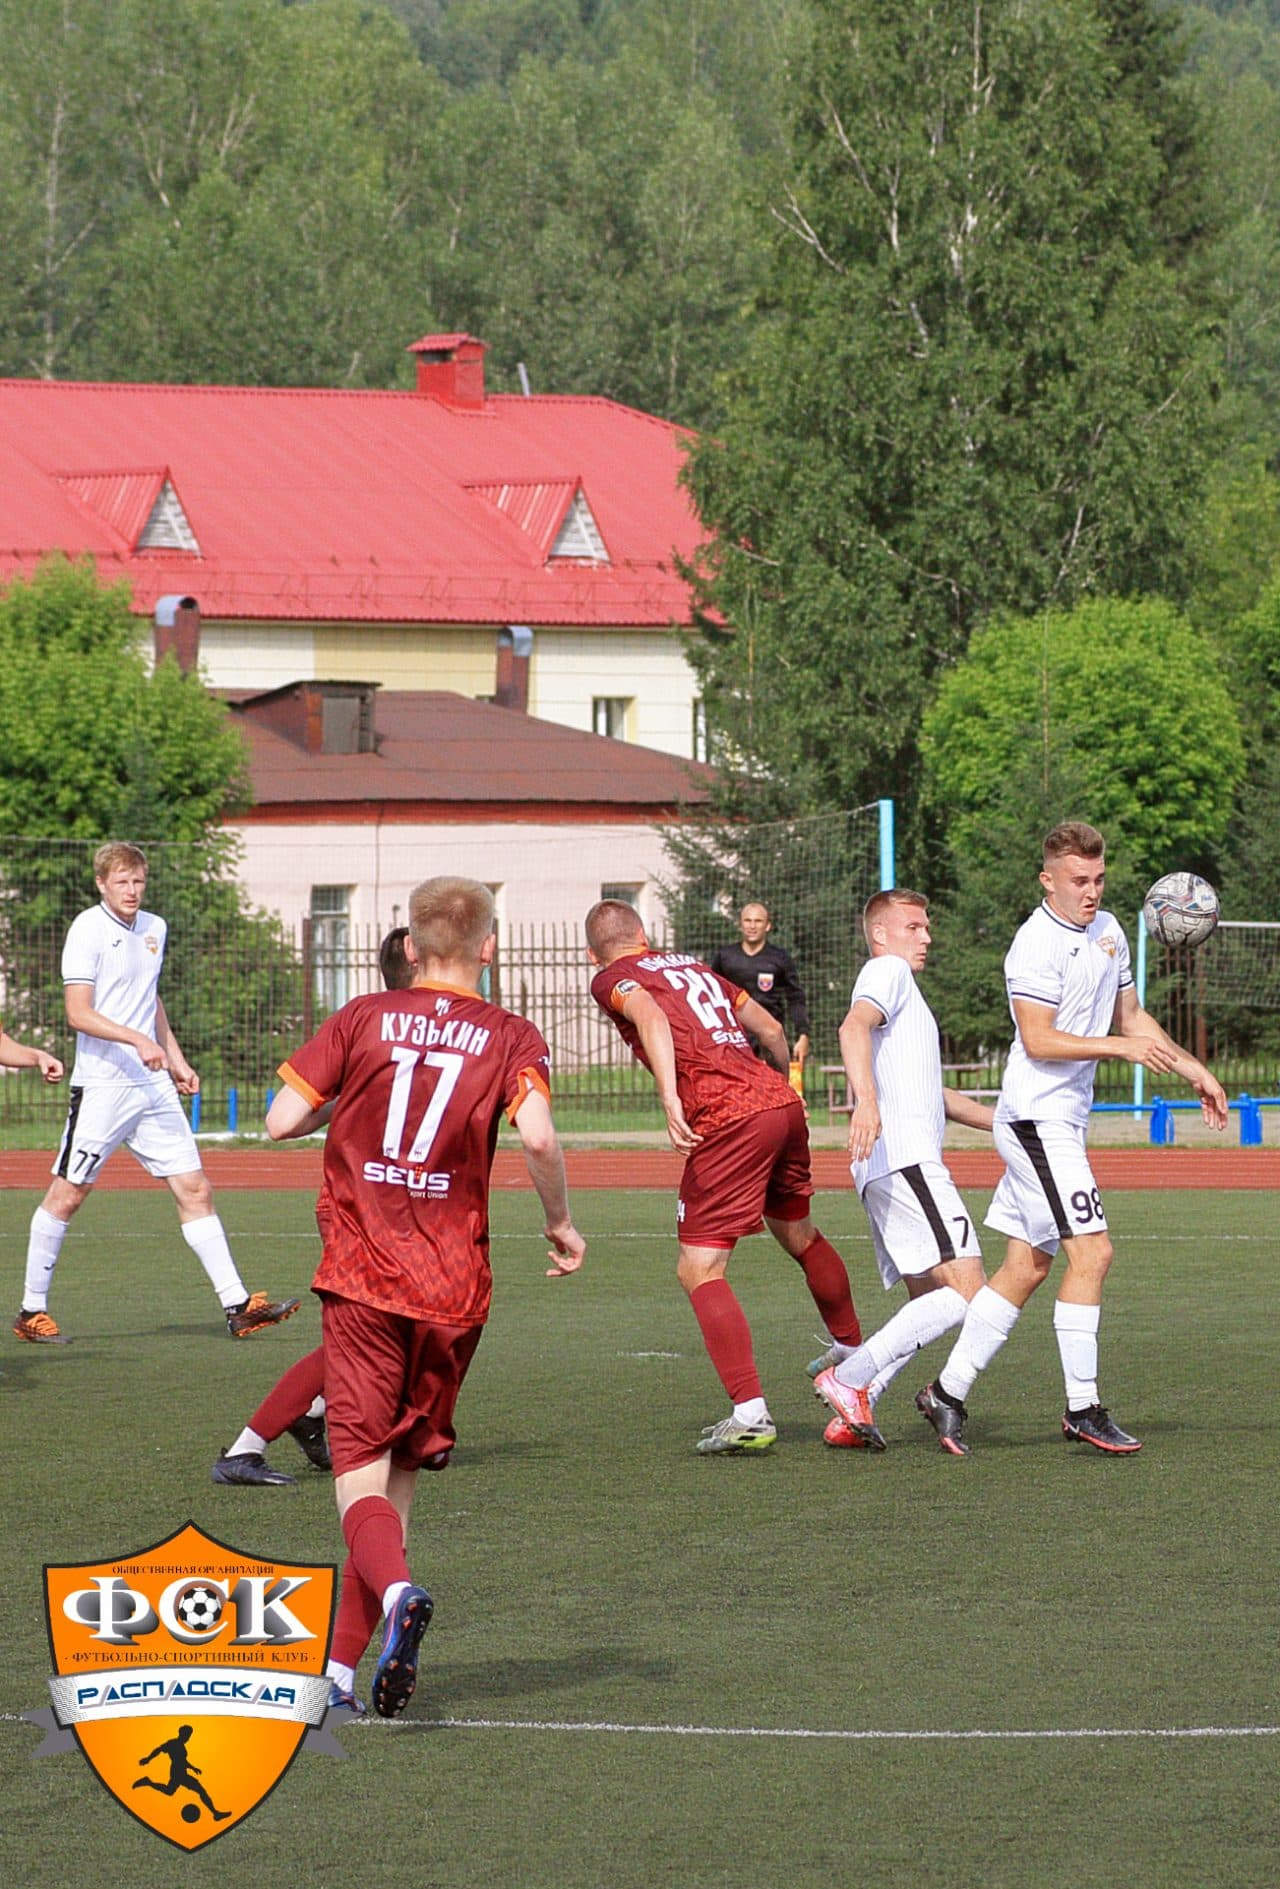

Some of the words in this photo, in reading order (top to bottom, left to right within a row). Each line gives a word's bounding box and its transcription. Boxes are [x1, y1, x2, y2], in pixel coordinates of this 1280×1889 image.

[663, 968, 736, 1029] 24
[380, 1012, 490, 1056] КУЗЬКИН
[382, 1046, 464, 1163] 17
[73, 1149, 101, 1177] 77
[363, 1161, 451, 1191] SEUS
[1070, 1187, 1105, 1224] 98
[953, 1216, 969, 1248] 7
